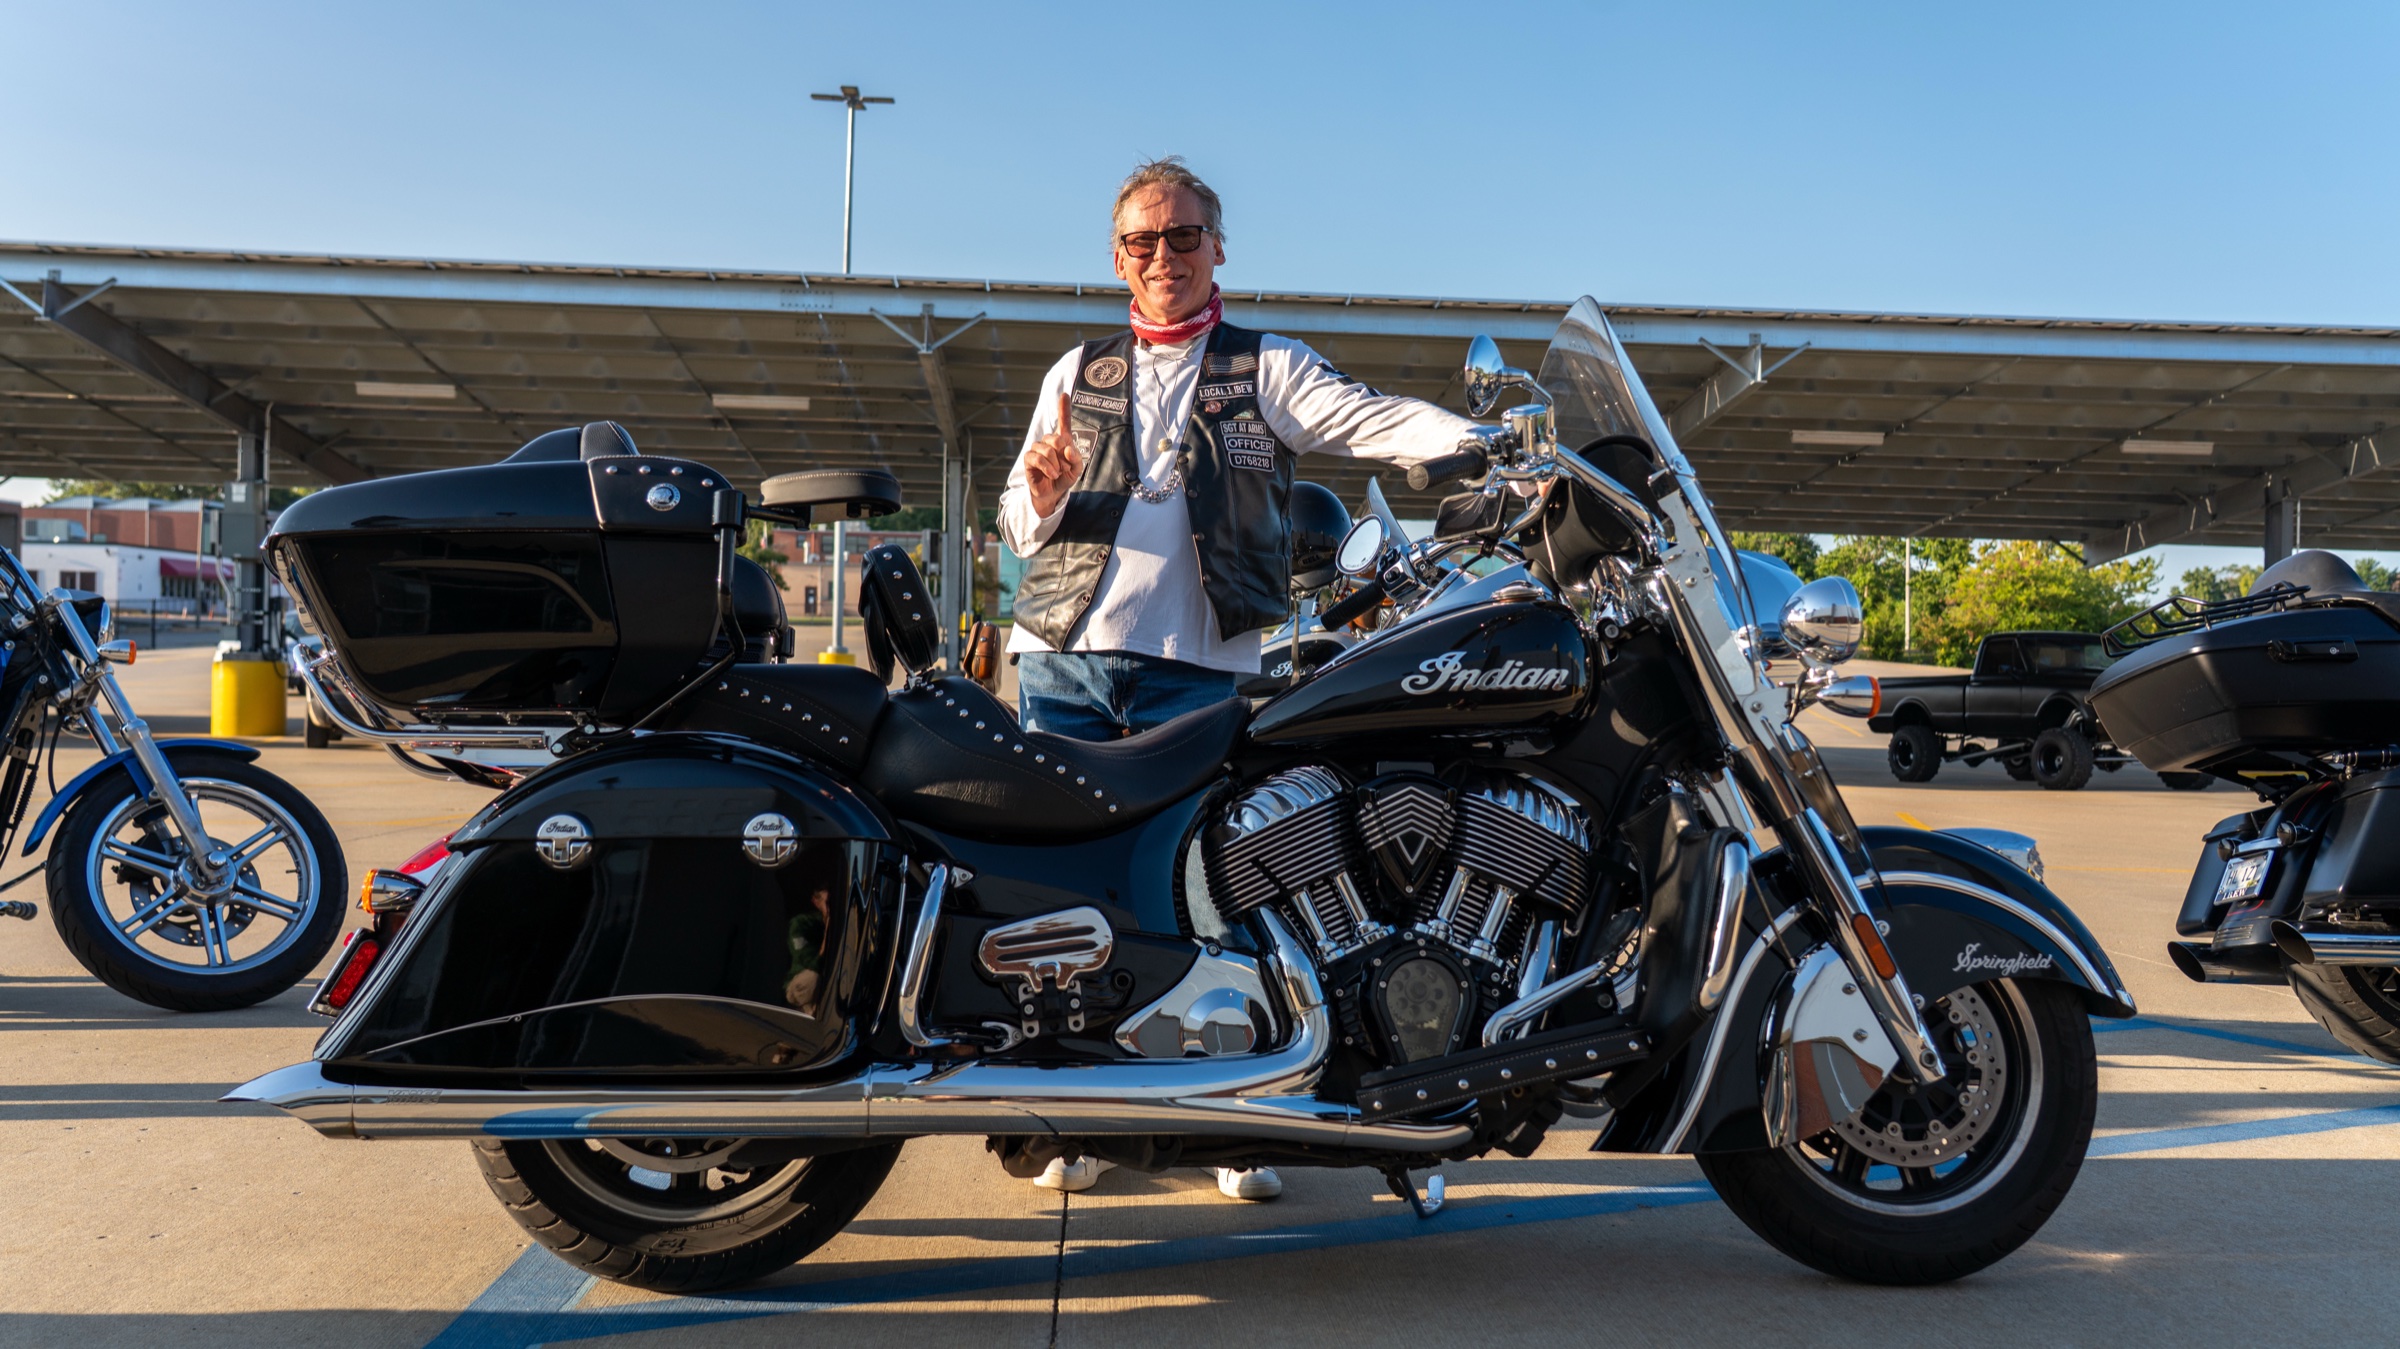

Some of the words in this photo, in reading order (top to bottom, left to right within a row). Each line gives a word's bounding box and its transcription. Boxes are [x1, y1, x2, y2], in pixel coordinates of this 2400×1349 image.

[1199, 387, 1226, 397] LOCAL
[1226, 386, 1232, 395] 1
[1233, 383, 1253, 394] IBEW
[1075, 394, 1102, 407] FOUNDING
[1101, 399, 1124, 411] MEMBER
[1222, 423, 1237, 433] SGT
[1238, 422, 1247, 433] AT
[1248, 423, 1265, 435] ARMS
[1228, 438, 1272, 452] OFFICER
[1234, 455, 1270, 468] D768218
[1400, 651, 1570, 696] Indian
[546, 821, 577, 833] Indian
[752, 820, 785, 832] Indian
[1952, 943, 2053, 976] Springfield
